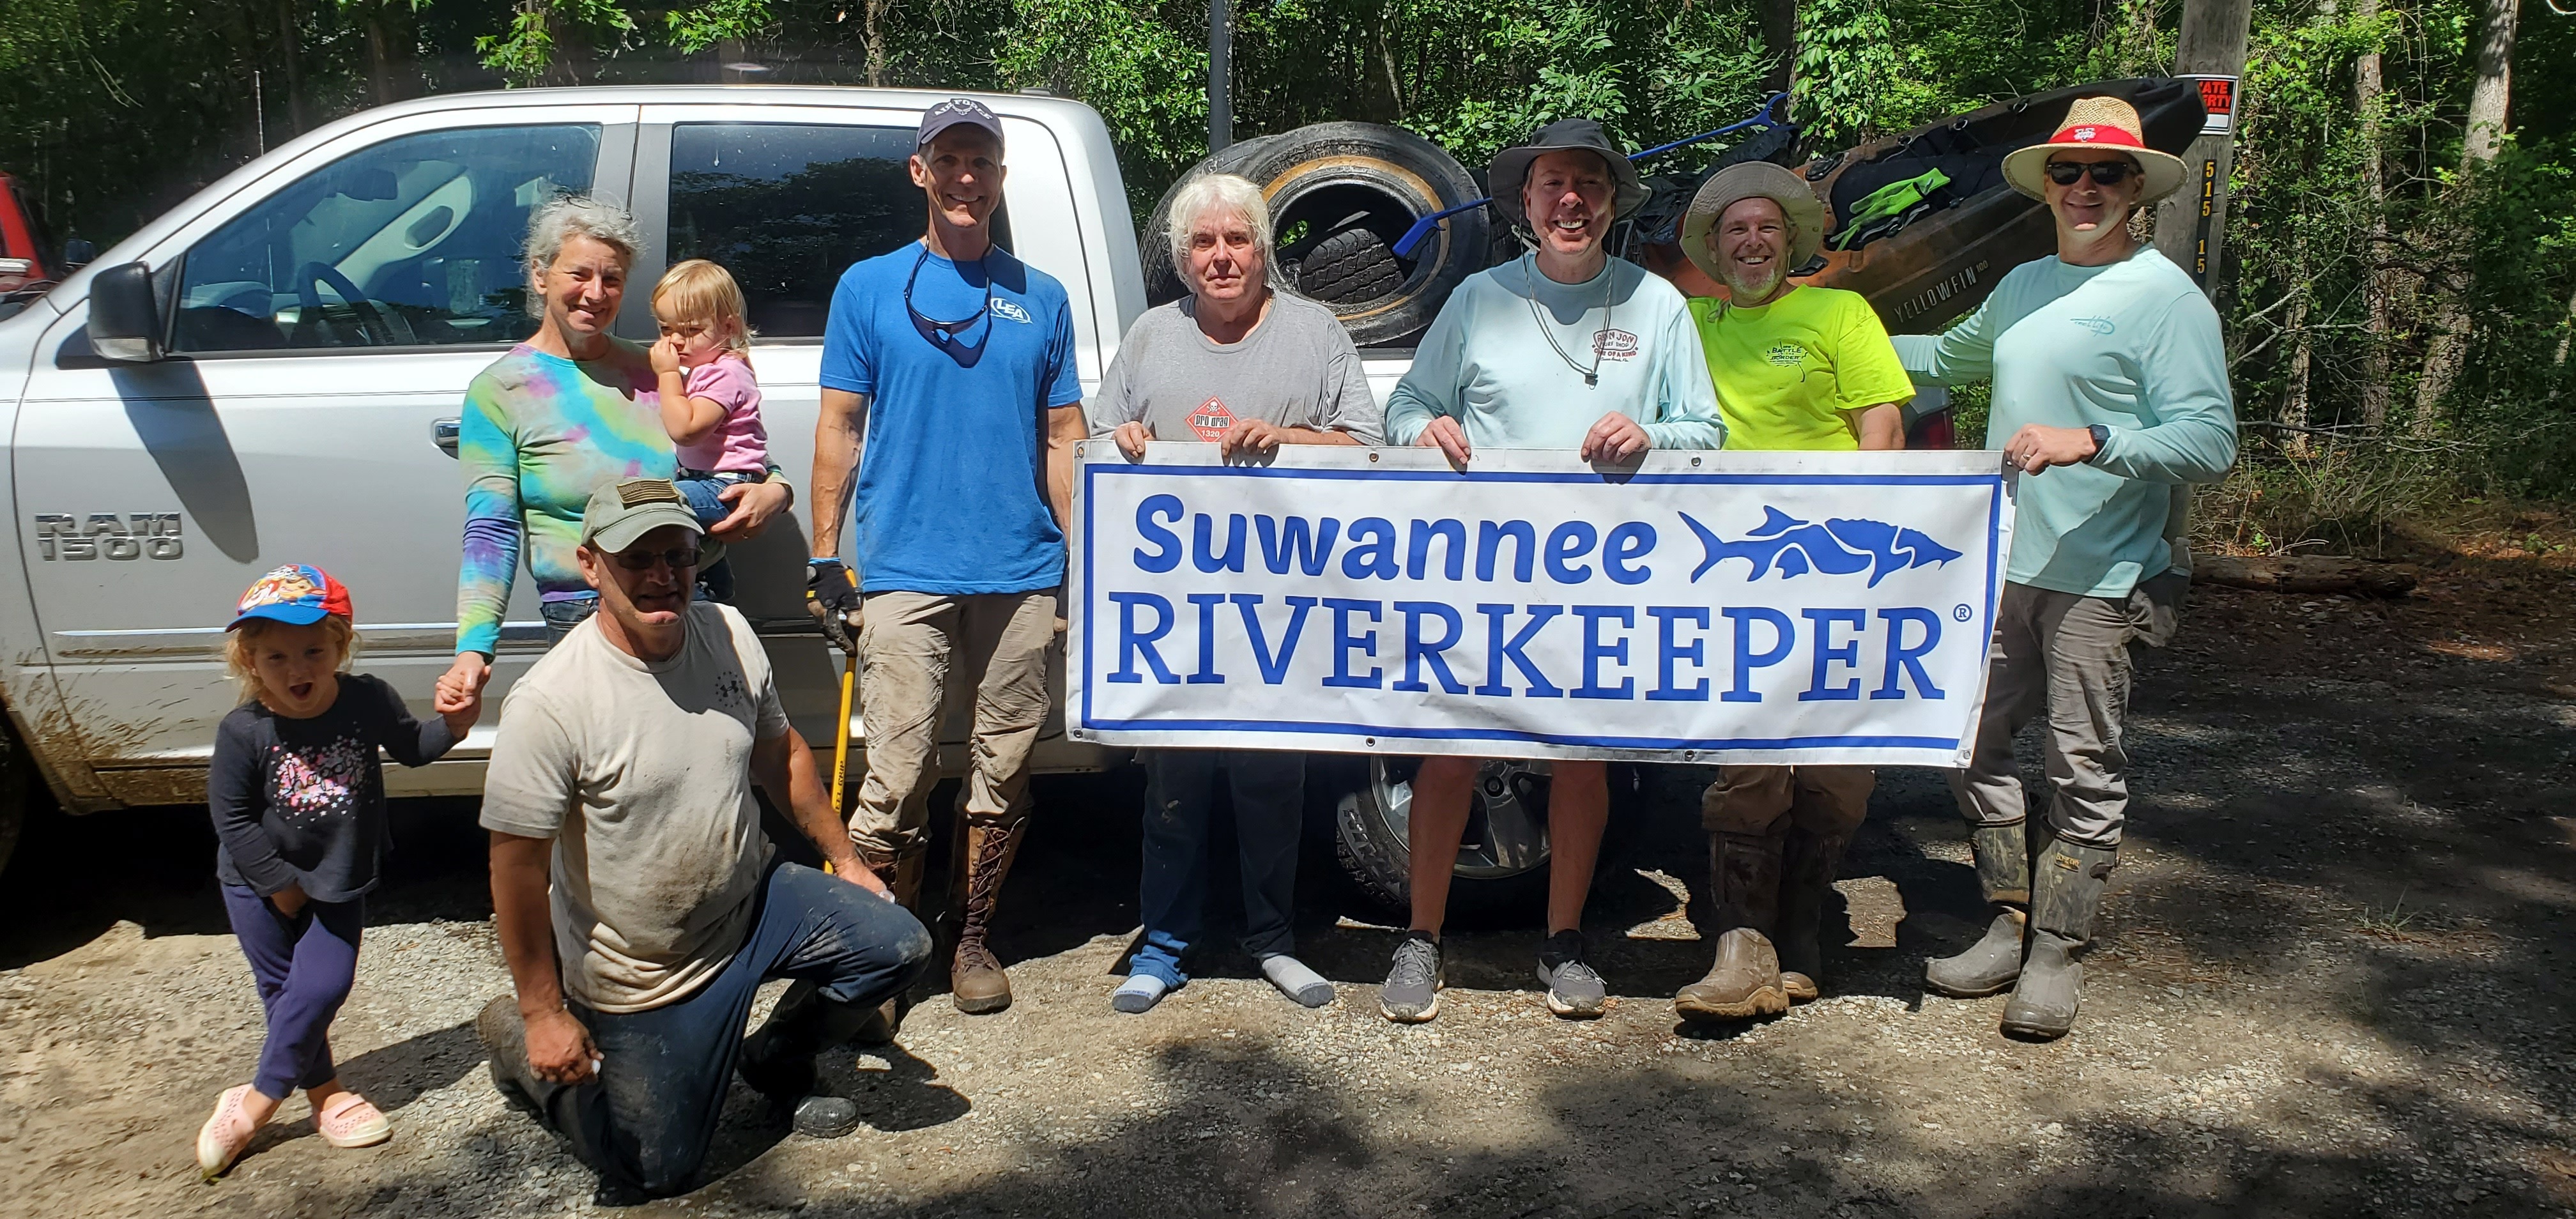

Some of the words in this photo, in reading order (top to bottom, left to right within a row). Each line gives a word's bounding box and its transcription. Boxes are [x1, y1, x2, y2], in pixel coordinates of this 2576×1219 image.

[934, 102, 954, 116] AIR
[953, 99, 993, 119] FORCE
[1894, 266, 1977, 323] YELLOWFIN
[1975, 260, 1989, 273] 100
[997, 300, 1024, 319] LEA
[1616, 334, 1634, 343] JON
[1195, 415, 1209, 425] pro
[1211, 417, 1229, 427] drag
[1202, 429, 1220, 438] 1320
[35, 512, 183, 537] RAM
[37, 536, 183, 562] 1500
[1133, 493, 1657, 585] Suwannee
[283, 761, 359, 796] happy
